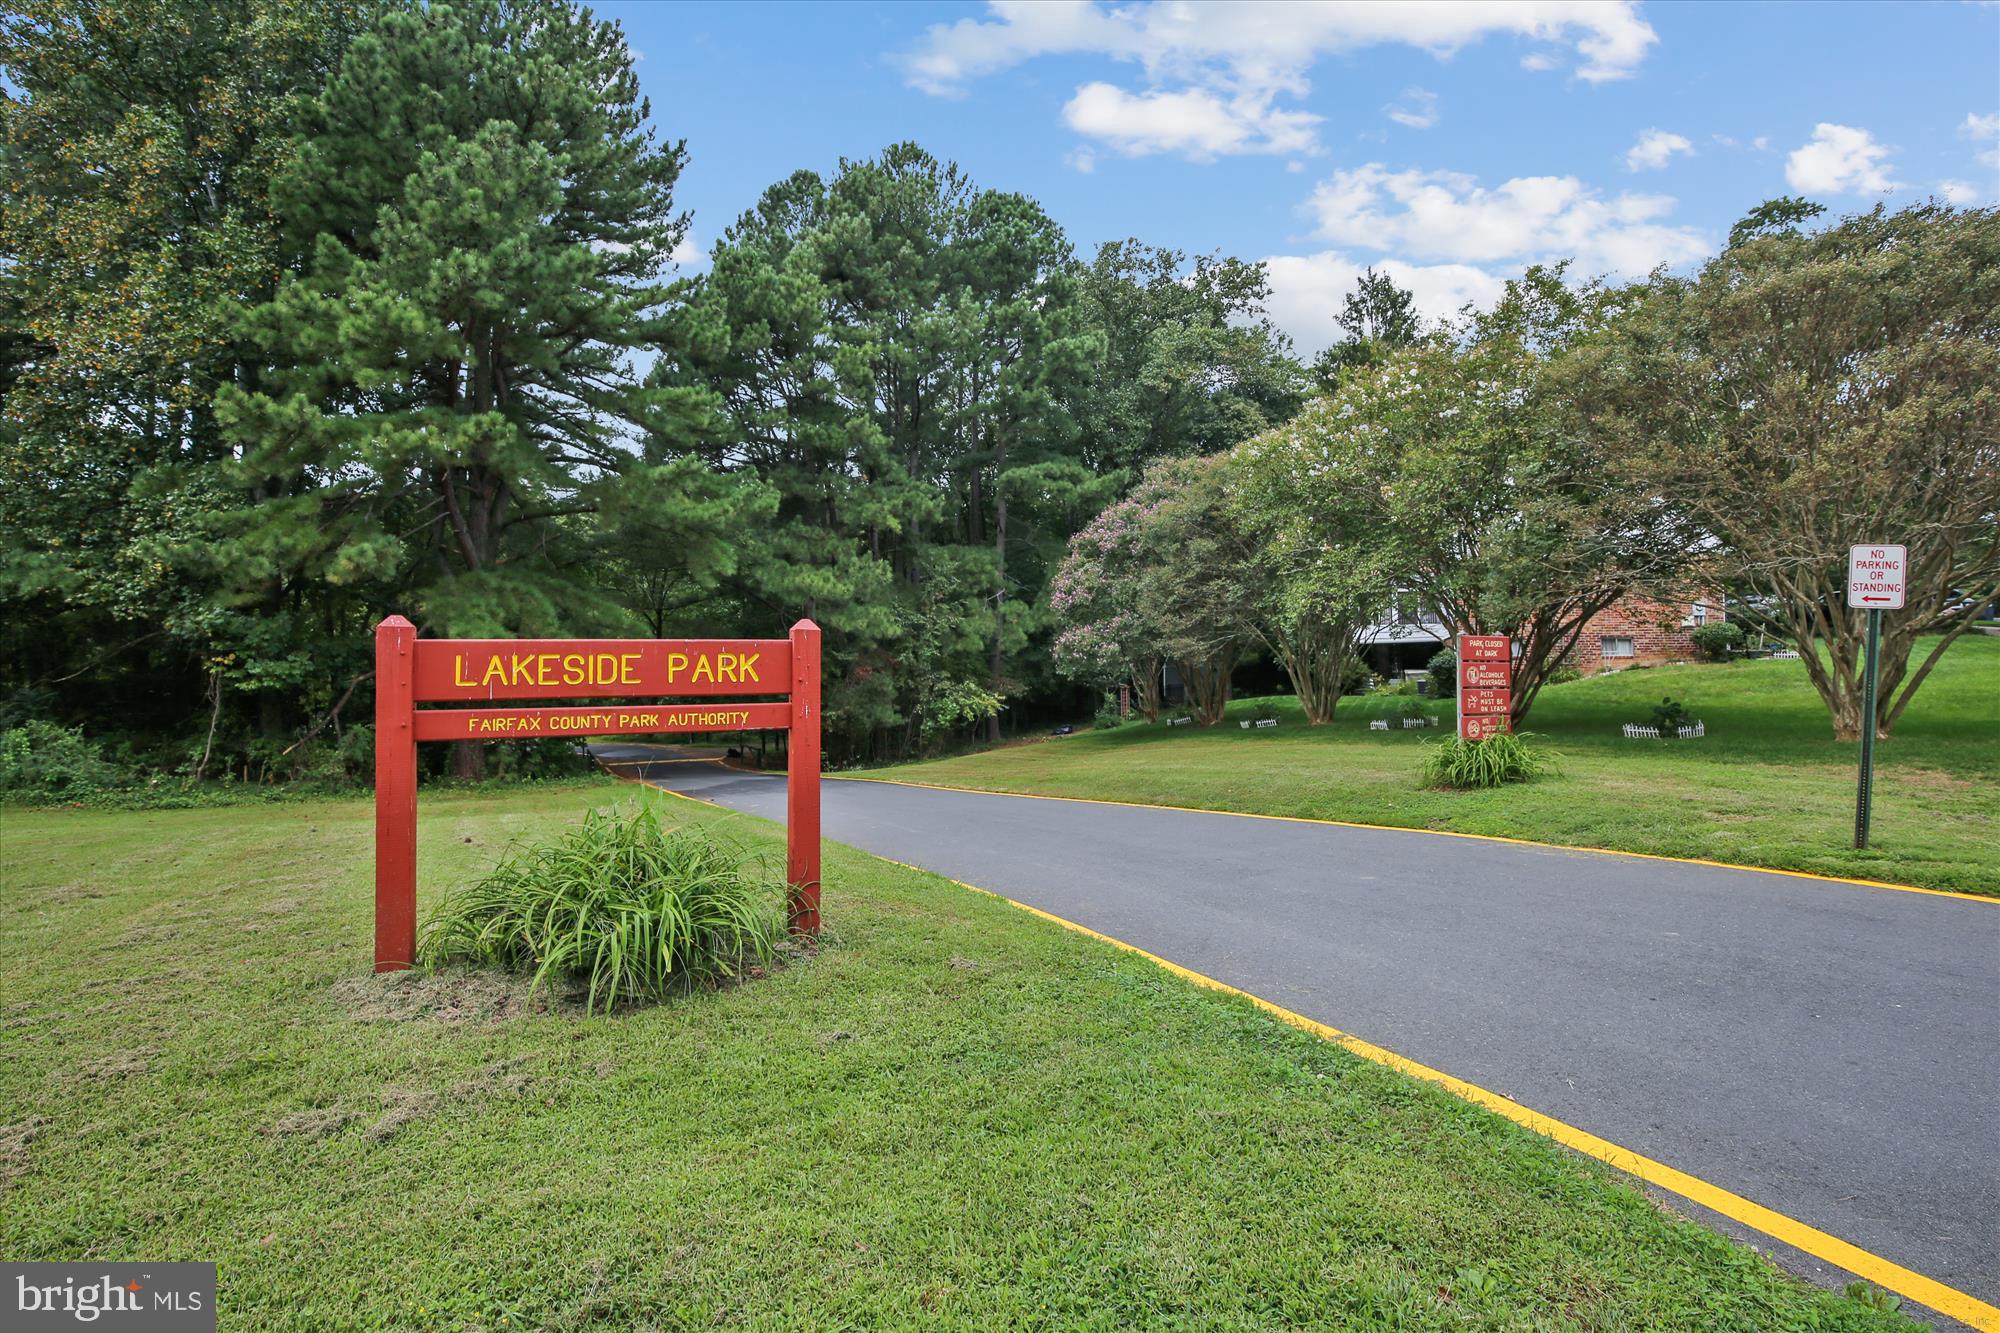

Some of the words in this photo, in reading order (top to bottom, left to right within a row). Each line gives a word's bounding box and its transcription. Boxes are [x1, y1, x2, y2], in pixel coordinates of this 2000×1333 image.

[1871, 550, 1885, 559] NO
[1856, 561, 1899, 570] PARKING
[1870, 571, 1884, 580] OR
[1852, 583, 1901, 592] STANDING
[455, 653, 642, 687] LAKESIDE
[667, 653, 760, 683] PARK
[469, 717, 541, 732] FAIRFAX
[550, 715, 612, 730] COUNTY
[619, 714, 659, 728] PARK
[668, 711, 749, 726] AUTHORITY
